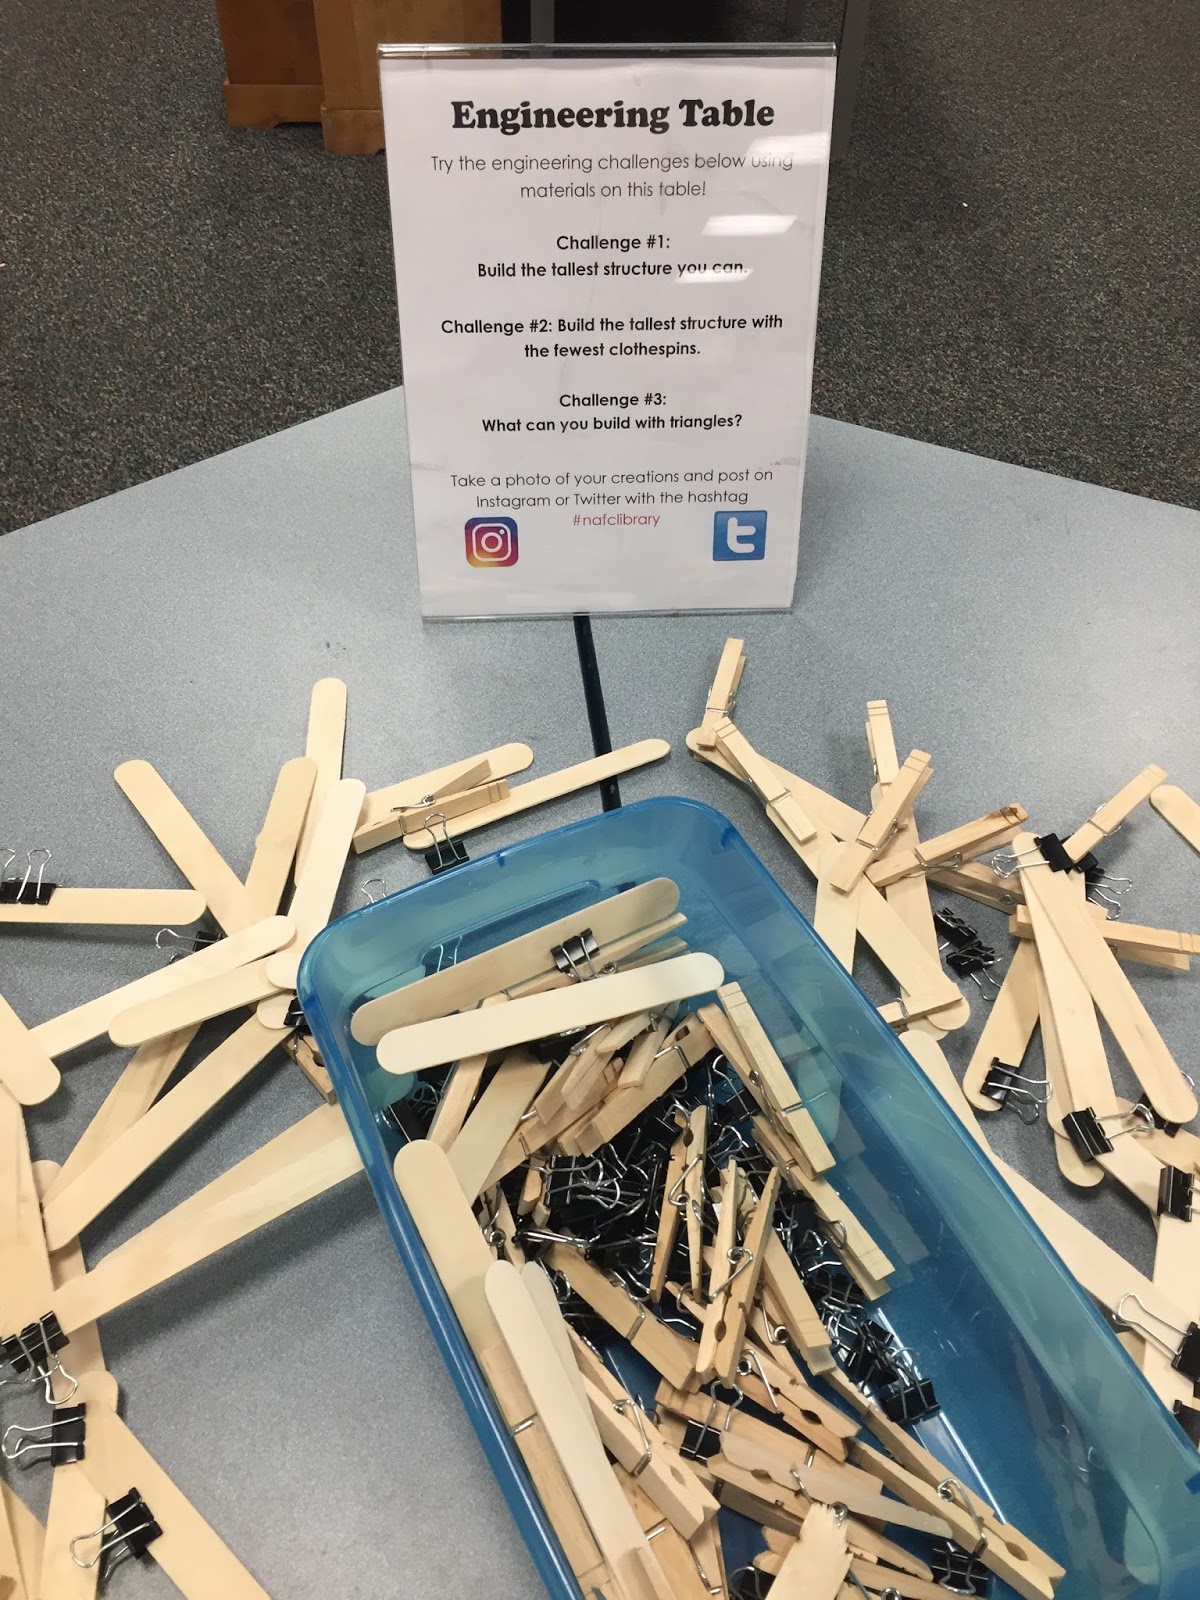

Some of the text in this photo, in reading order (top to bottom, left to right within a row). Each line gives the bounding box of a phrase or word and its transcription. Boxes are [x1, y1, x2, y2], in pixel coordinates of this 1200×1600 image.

[451, 99, 775, 136] Engineering Table
[431, 153, 793, 174] Try the engineering challenges below using
[521, 181, 705, 198] materials on this table!
[557, 234, 670, 253] Challenge #1:
[478, 261, 748, 277] Build the tallest structure you can.
[441, 314, 782, 336] Challenge #2: Build the tallest structure with
[524, 341, 700, 358] the fewest clothespins.
[559, 393, 666, 409] Challenge #3:
[482, 414, 742, 433] What can you build with triangles?
[451, 469, 772, 489] Take a photo of your creations and post on
[477, 490, 748, 510] Instagram or Twitter with the hashtag
[573, 514, 660, 527] #nafclibrary
